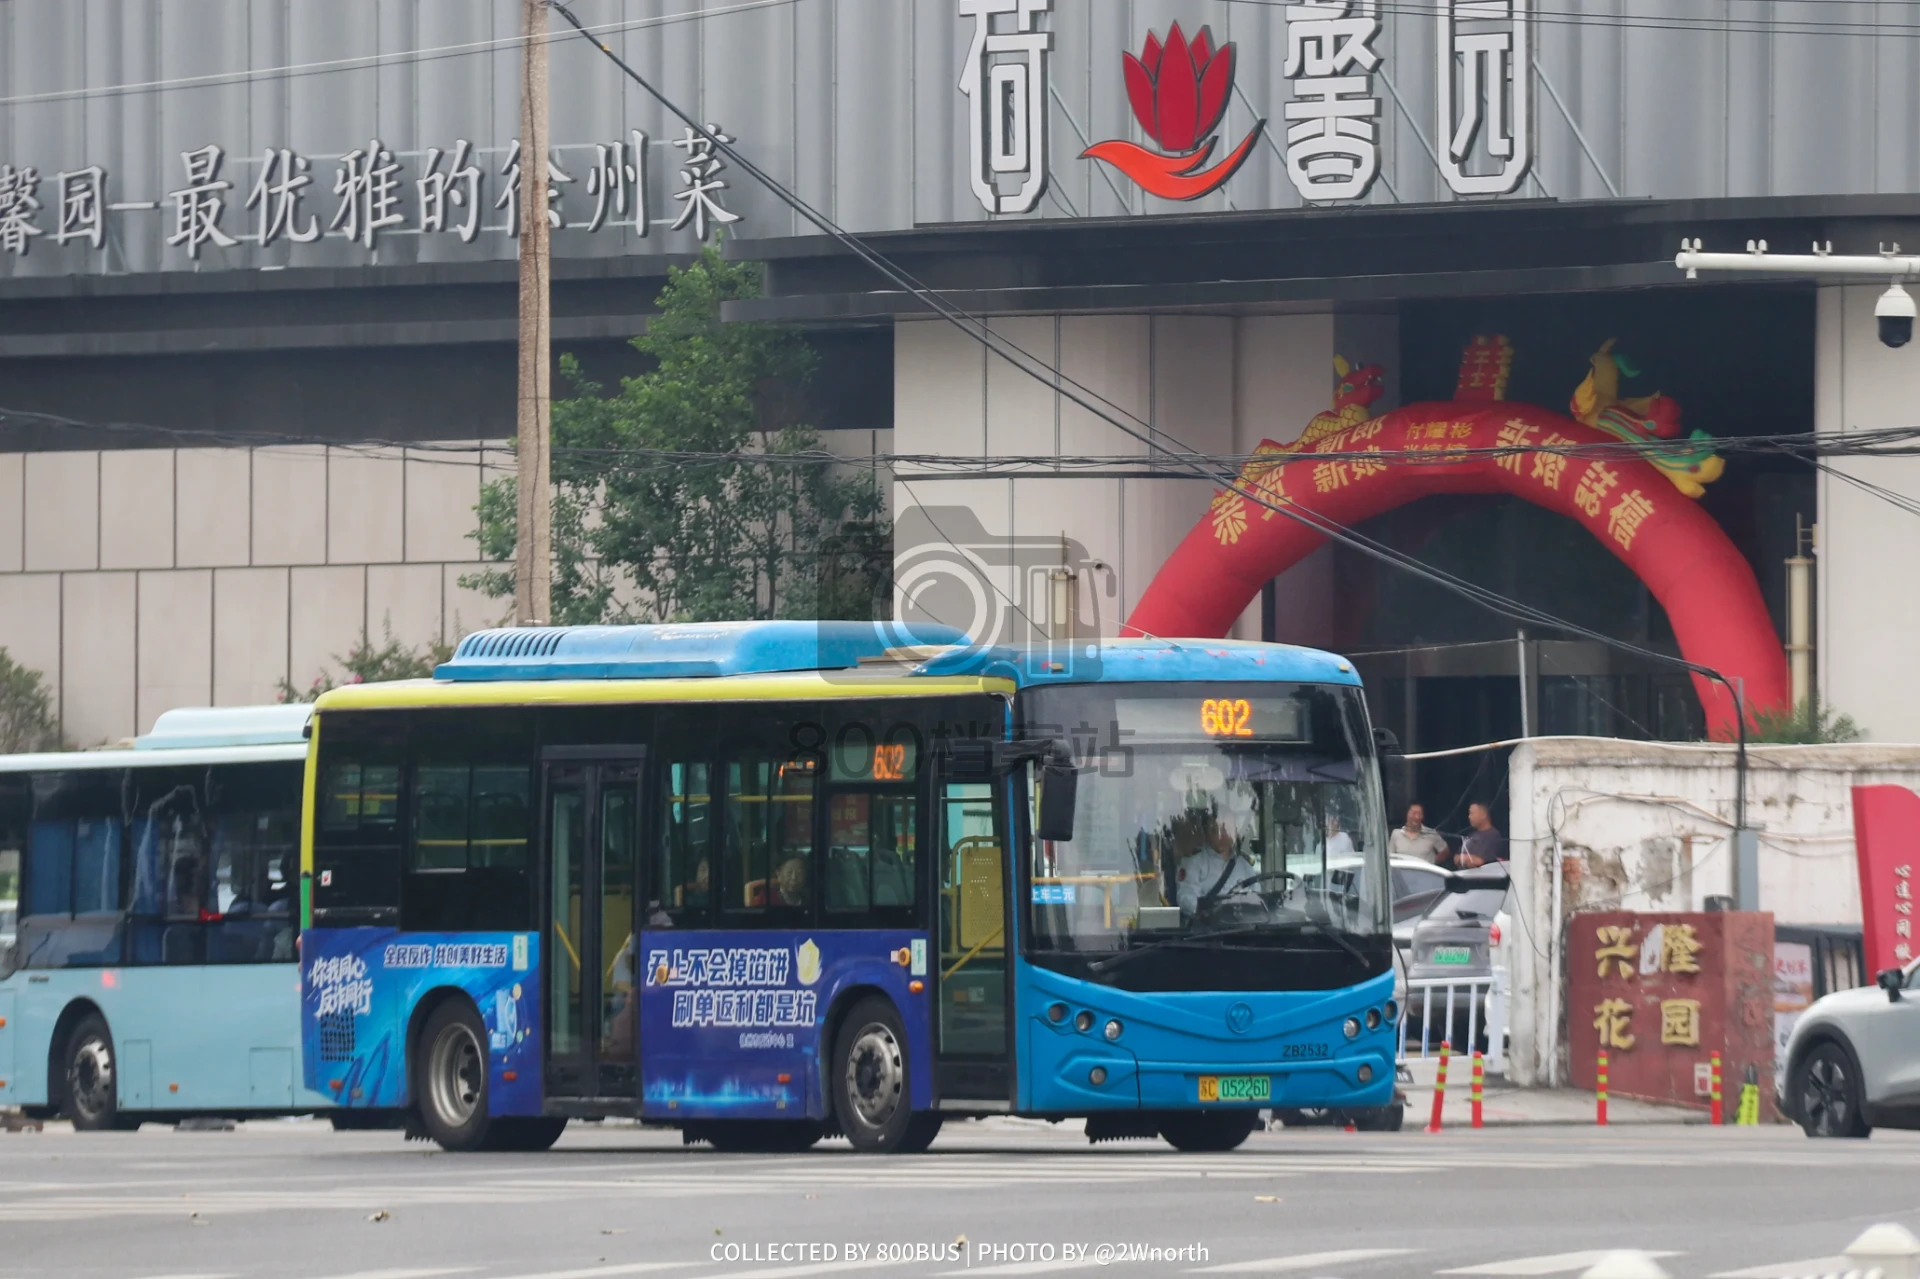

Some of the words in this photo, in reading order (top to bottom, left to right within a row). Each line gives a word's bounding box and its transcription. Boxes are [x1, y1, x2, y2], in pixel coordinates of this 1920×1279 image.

[1201, 698, 1253, 736] 602
[872, 744, 906, 780] 602
[1031, 887, 1074, 902] 上车二元
[384, 944, 433, 968] 全民反诈
[433, 944, 508, 968] 共创美好生活
[1595, 923, 1703, 980] 兴隆
[307, 952, 367, 989] 你我同心
[314, 978, 373, 1019] 反诈同行
[672, 989, 817, 1027] 刷单返利都是坑
[1593, 998, 1702, 1050] 花园
[1283, 1043, 1329, 1058] ZB2532
